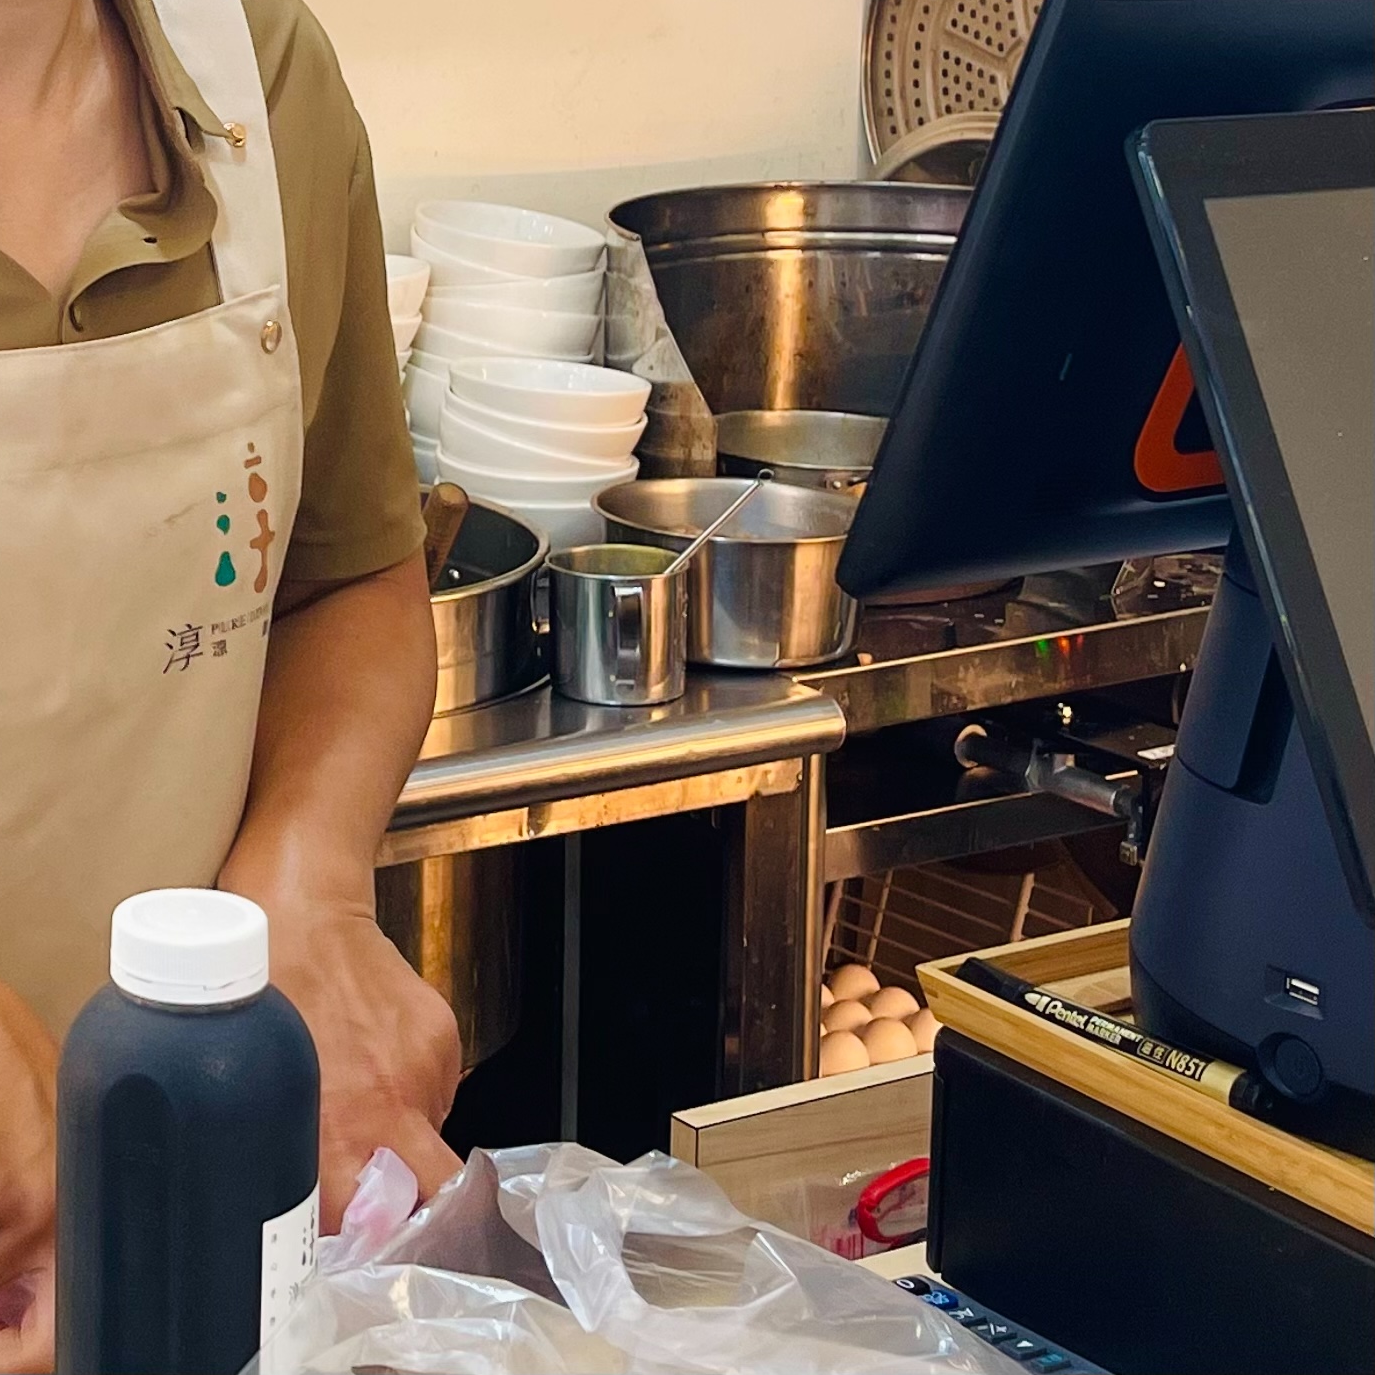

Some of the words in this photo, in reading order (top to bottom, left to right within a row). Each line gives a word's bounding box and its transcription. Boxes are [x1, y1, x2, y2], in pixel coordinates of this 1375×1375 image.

[163, 623, 203, 674] 淳
[1045, 1000, 1090, 1030] Pentel
[1090, 1015, 1144, 1043] PERMANENT
[1086, 1023, 1122, 1046] MARKER
[1166, 1050, 1207, 1080] N851
